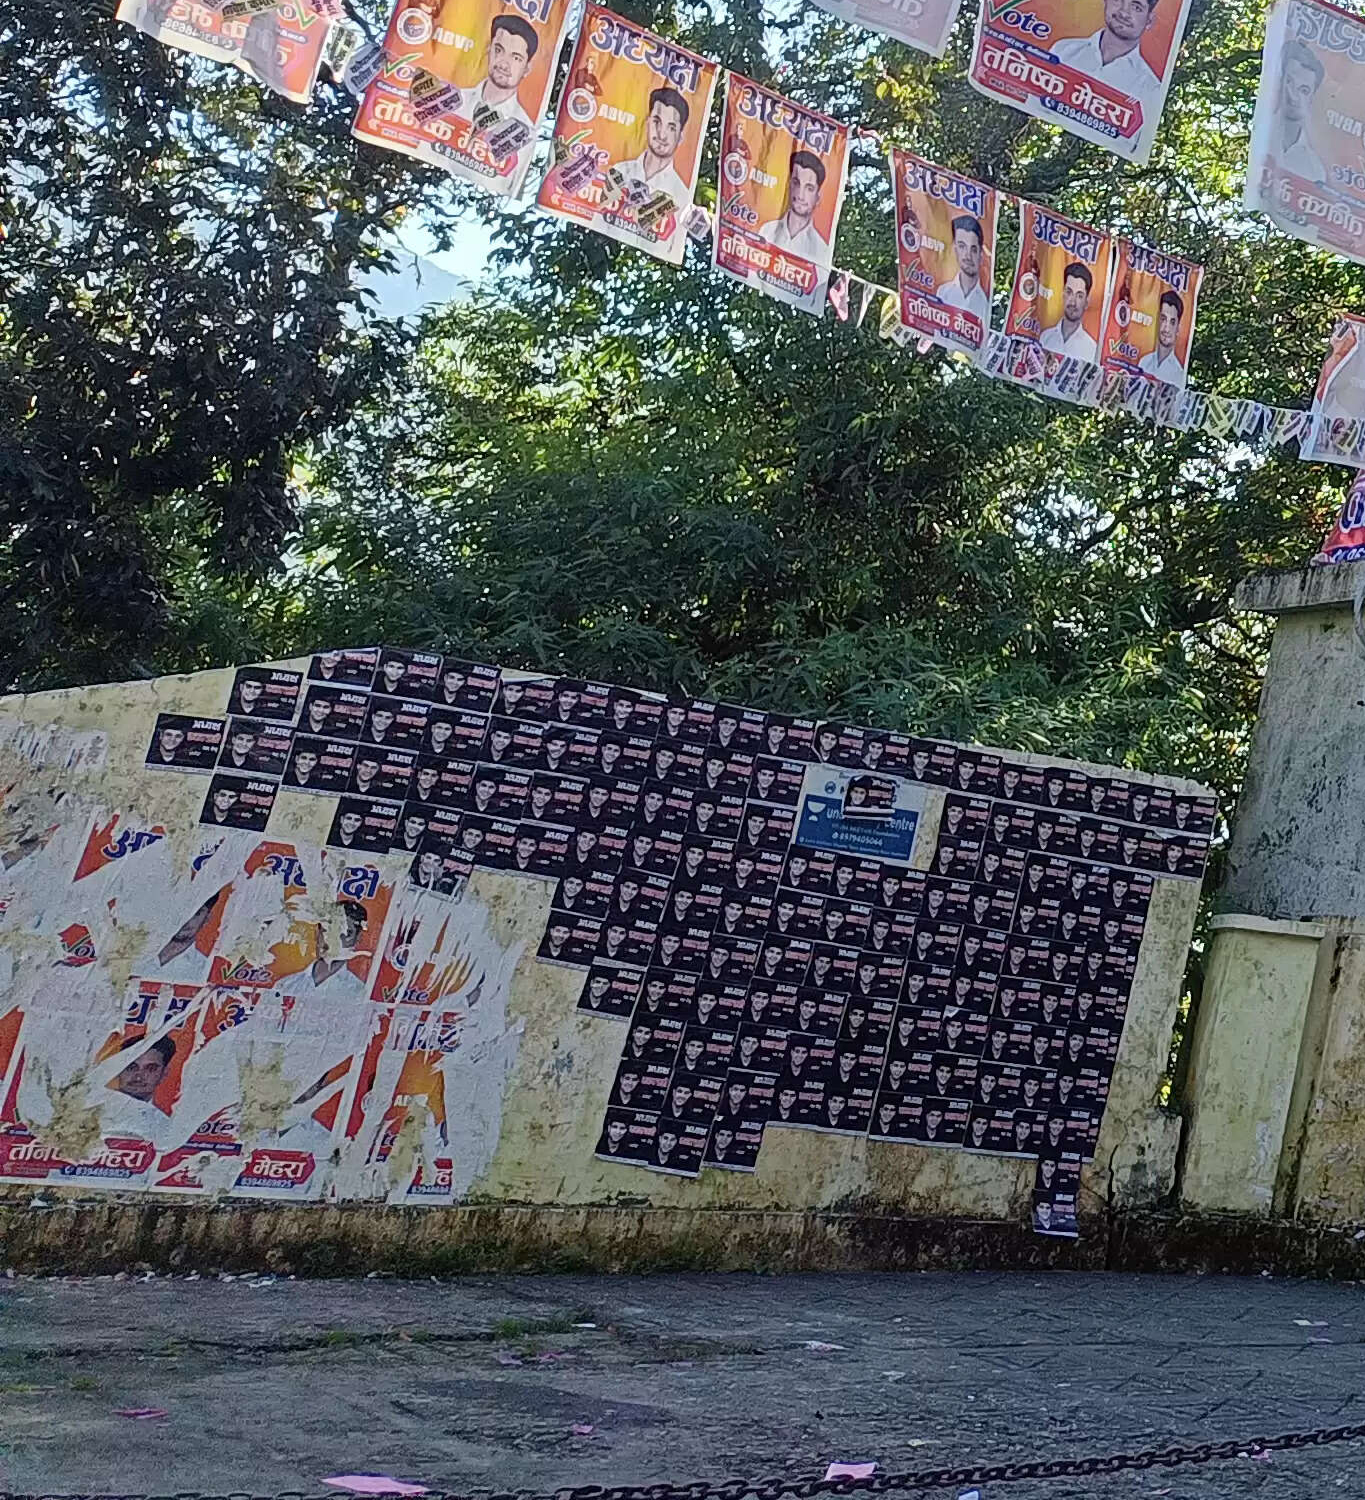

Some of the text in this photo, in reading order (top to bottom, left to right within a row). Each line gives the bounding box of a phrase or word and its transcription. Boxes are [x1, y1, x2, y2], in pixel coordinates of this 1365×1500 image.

[591, 16, 703, 94] अध्यक्ष
[982, 43, 1133, 126] तनिष्क मेहरा
[737, 83, 836, 154] अध्यक्ष
[1056, 102, 1118, 138] 8394869825
[904, 159, 986, 217] अध्यक्ष
[1032, 212, 1103, 265] अध्यक्ष
[253, 1156, 304, 1178] मेहरा
